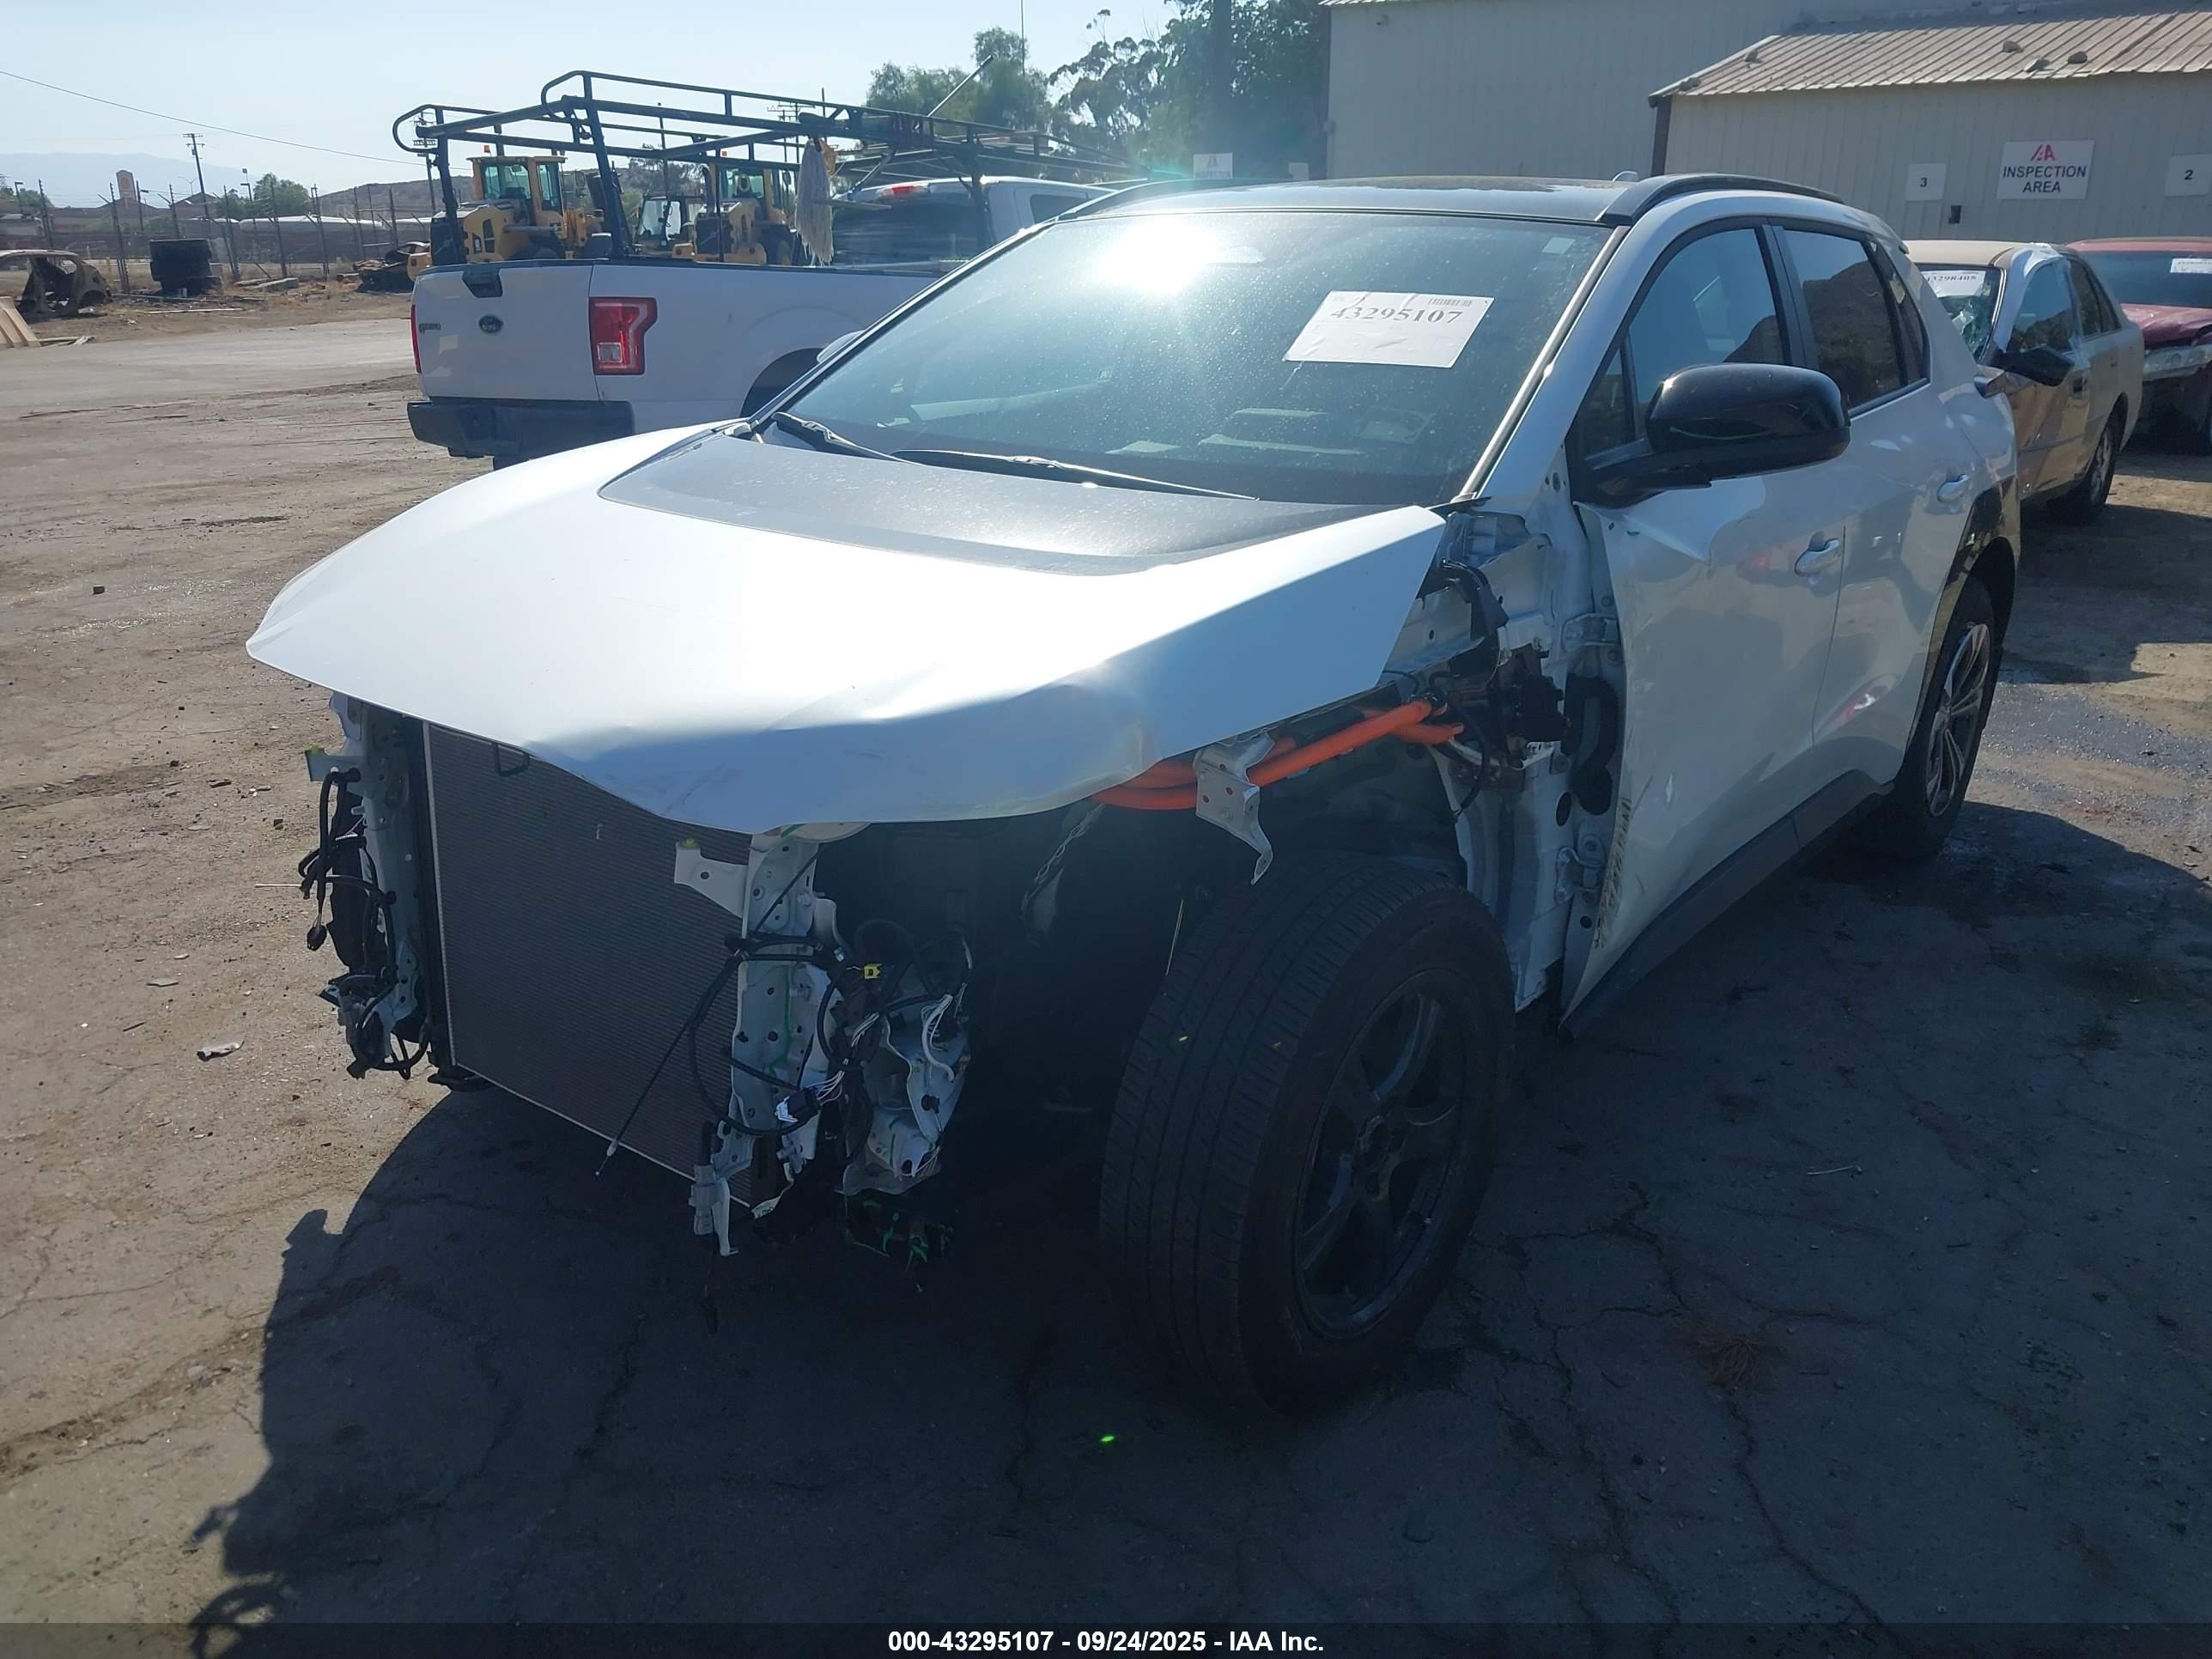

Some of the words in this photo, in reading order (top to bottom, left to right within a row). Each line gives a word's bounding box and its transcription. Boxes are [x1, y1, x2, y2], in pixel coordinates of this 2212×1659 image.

[2002, 165, 2087, 179] INSPECTION
[2184, 169, 2195, 181] 2
[1919, 176, 1929, 188] 3
[2022, 180, 2062, 193] AREA
[1330, 307, 1464, 324] 43295107
